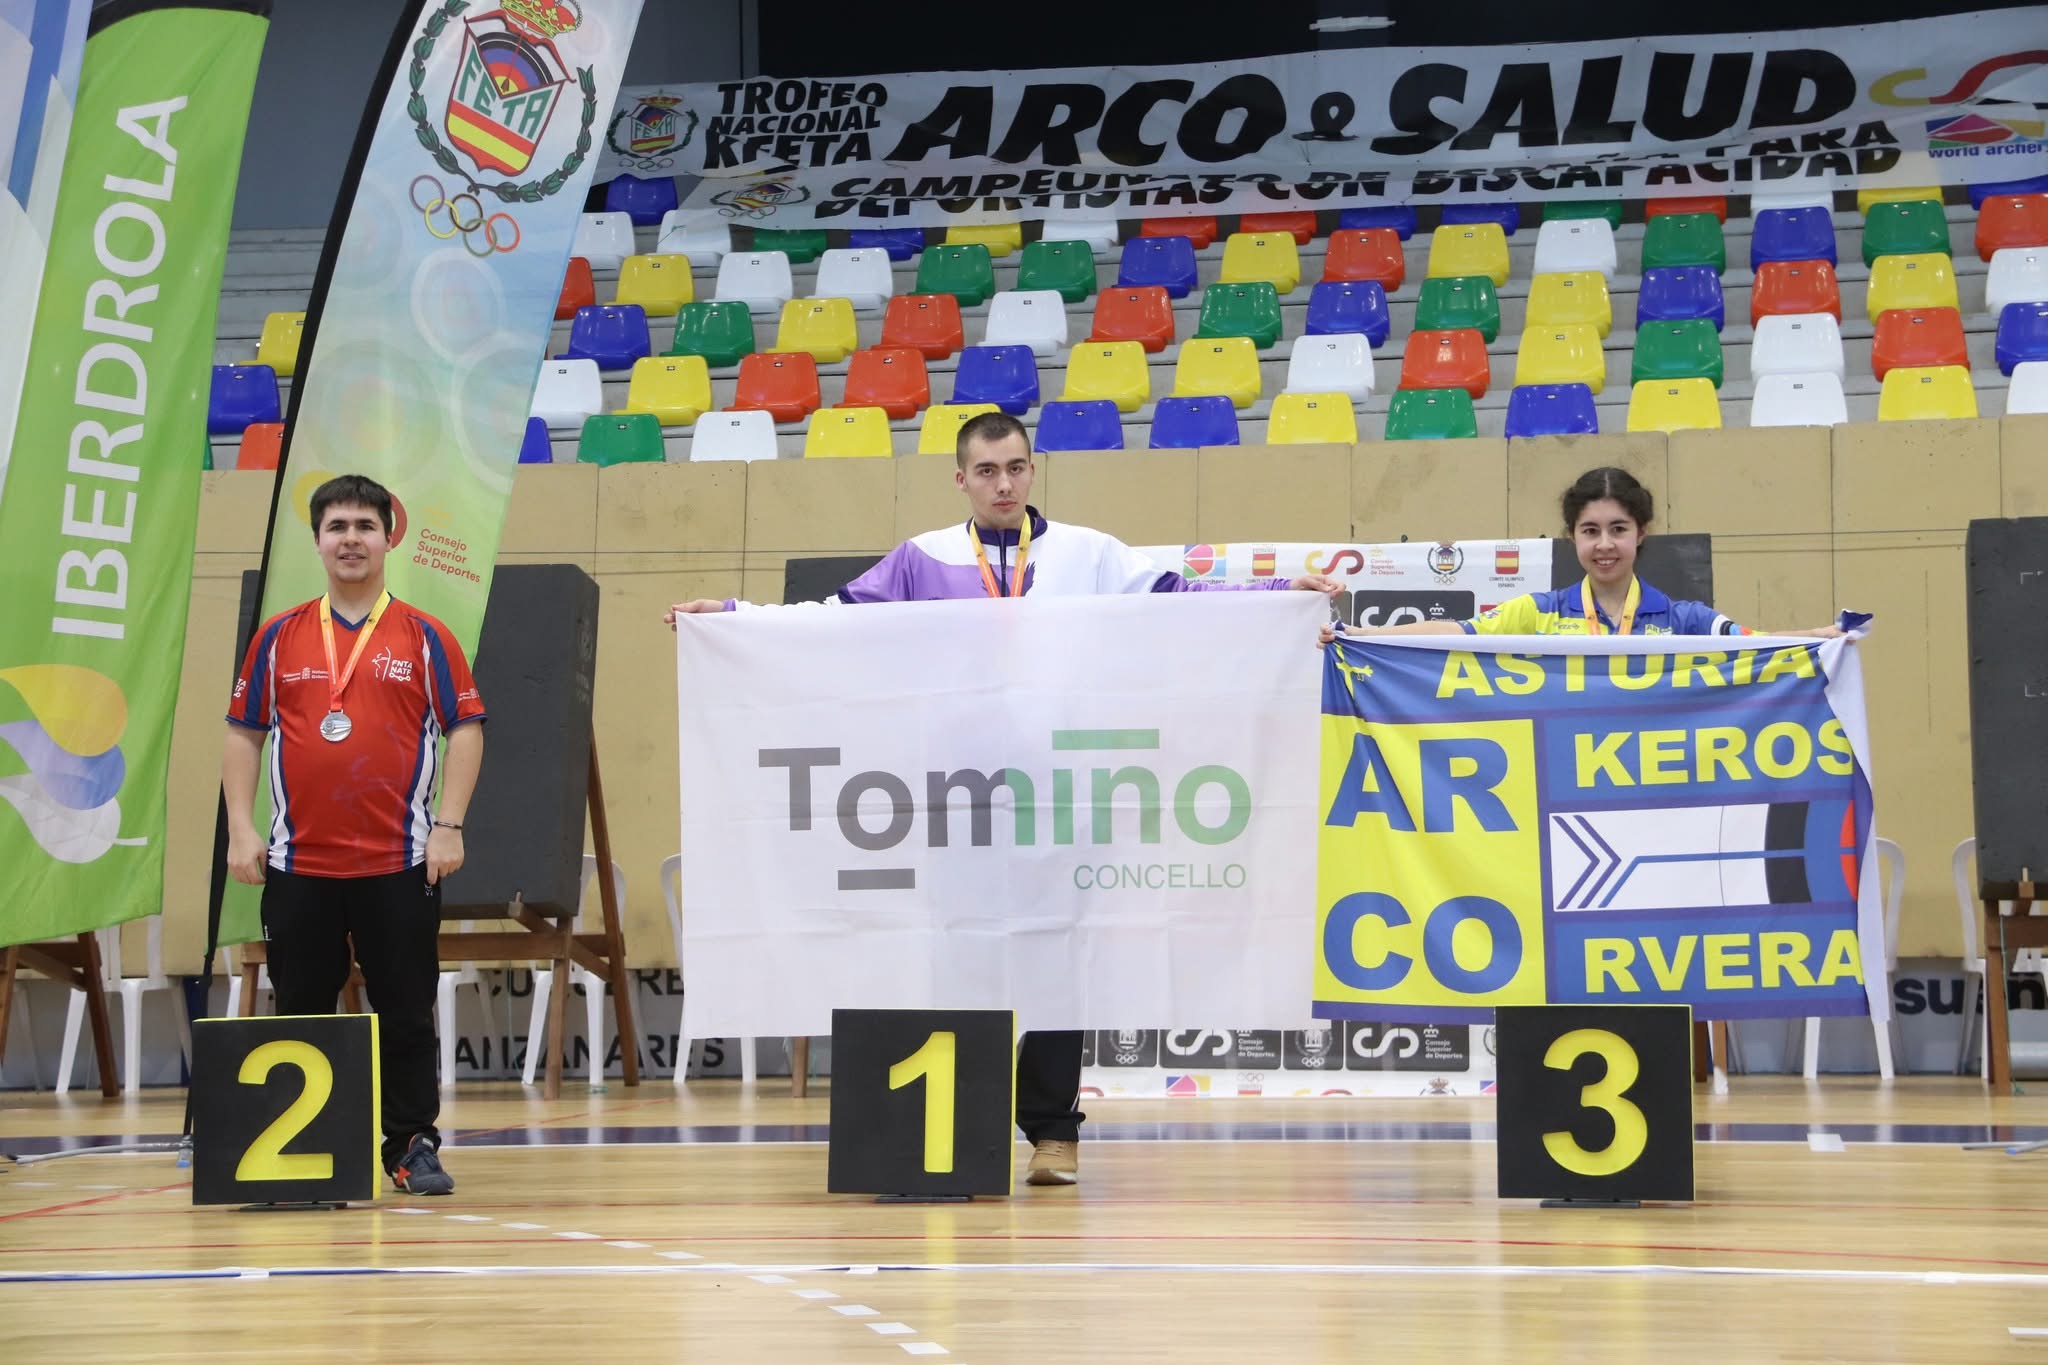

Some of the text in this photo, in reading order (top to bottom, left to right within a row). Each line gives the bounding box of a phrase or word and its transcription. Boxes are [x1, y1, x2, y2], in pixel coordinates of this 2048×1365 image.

[458, 44, 553, 140] FETA
[709, 105, 881, 136] NACIONAL
[718, 79, 888, 115] TROFEO
[882, 73, 1287, 166] ARCO
[1369, 48, 1857, 156] SALUD
[1928, 146, 1980, 159] world
[52, 95, 188, 640] IBERDROLA
[413, 553, 481, 583] de Deportes
[417, 540, 468, 564] Superior
[420, 528, 467, 552] Consejo
[391, 659, 413, 669] FNTA
[1436, 644, 1823, 699] ASTURIA
[1325, 732, 1519, 833] AR
[1575, 718, 1854, 788] KEROS
[1073, 863, 1247, 890] CONCELLO
[1323, 891, 1523, 994] CO
[1583, 928, 1866, 994] RVERA
[235, 1039, 334, 1182] 2
[888, 1031, 956, 1173] 1
[1542, 1028, 1649, 1176] 3
